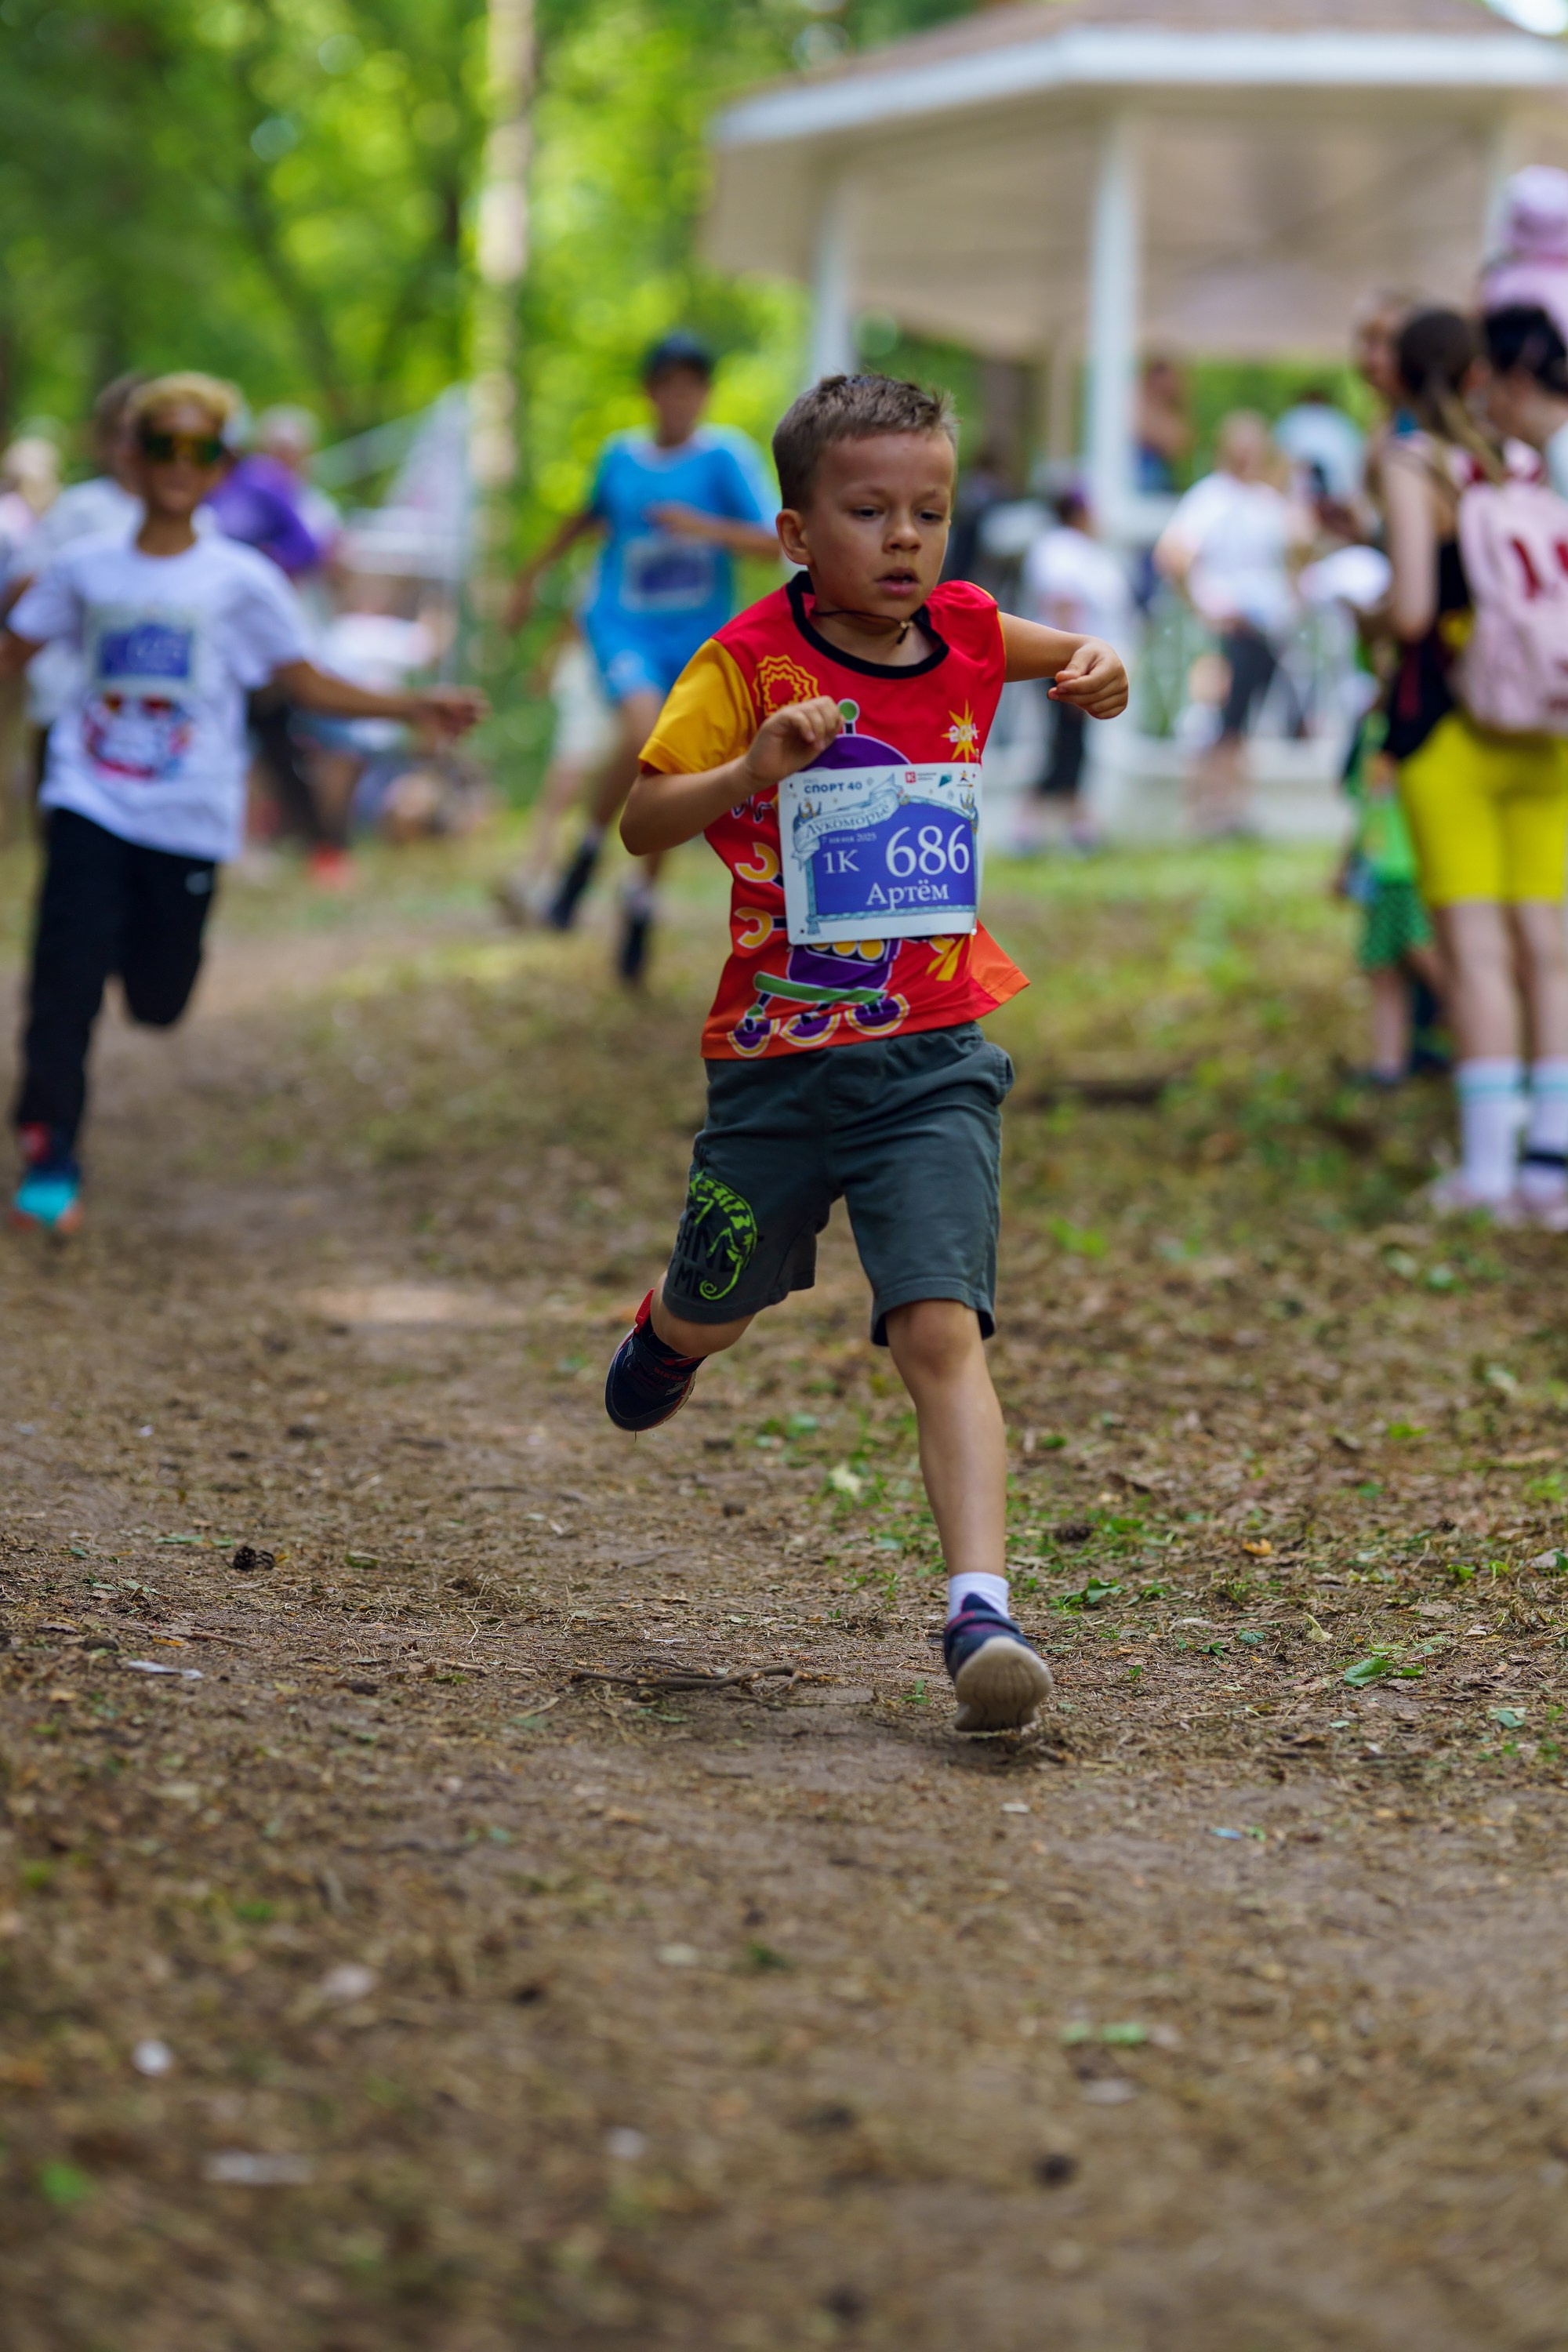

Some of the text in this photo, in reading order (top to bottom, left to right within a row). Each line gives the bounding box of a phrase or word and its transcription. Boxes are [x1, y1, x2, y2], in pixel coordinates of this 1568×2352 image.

[804, 781, 863, 794] СПОРТ 40
[885, 823, 970, 878] 686
[866, 879, 950, 912] Артём
